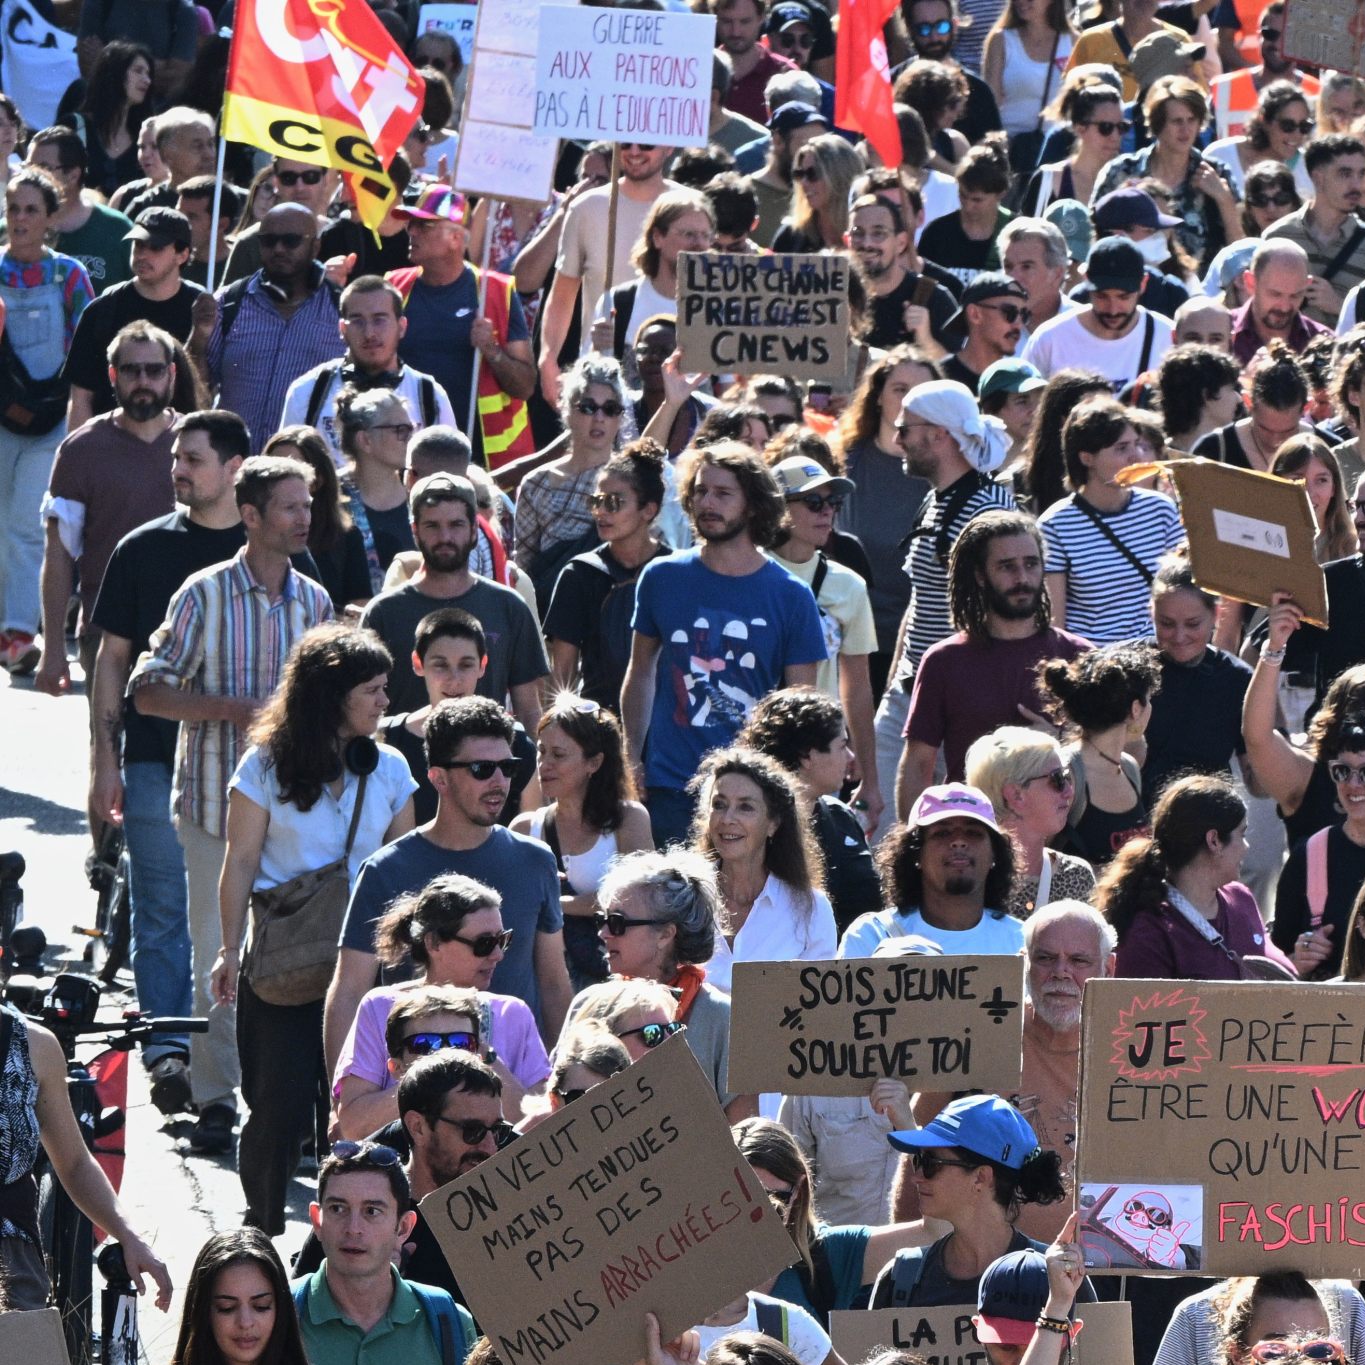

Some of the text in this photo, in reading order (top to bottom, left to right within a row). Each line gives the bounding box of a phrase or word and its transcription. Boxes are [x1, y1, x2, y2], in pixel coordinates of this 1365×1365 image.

[592, 13, 667, 46] GUERRE
[549, 51, 699, 89] AUX PATRONS
[534, 88, 707, 137] PAS À L'EDUCATION
[711, 331, 830, 366] CNEWS
[882, 963, 979, 1005] JEUNE
[852, 1006, 897, 1041] ET
[1127, 1018, 1188, 1069] JE
[787, 1036, 921, 1080] SOULEVE
[1106, 1077, 1209, 1122] ÊTRE
[1225, 1083, 1299, 1122] UNE
[446, 1075, 656, 1232] ON VEUT DES
[1207, 1130, 1363, 1182] QU'UNE
[481, 1115, 681, 1261] MAINS TENDUES
[524, 1176, 664, 1282] PAS DES
[892, 1317, 938, 1348] LA
